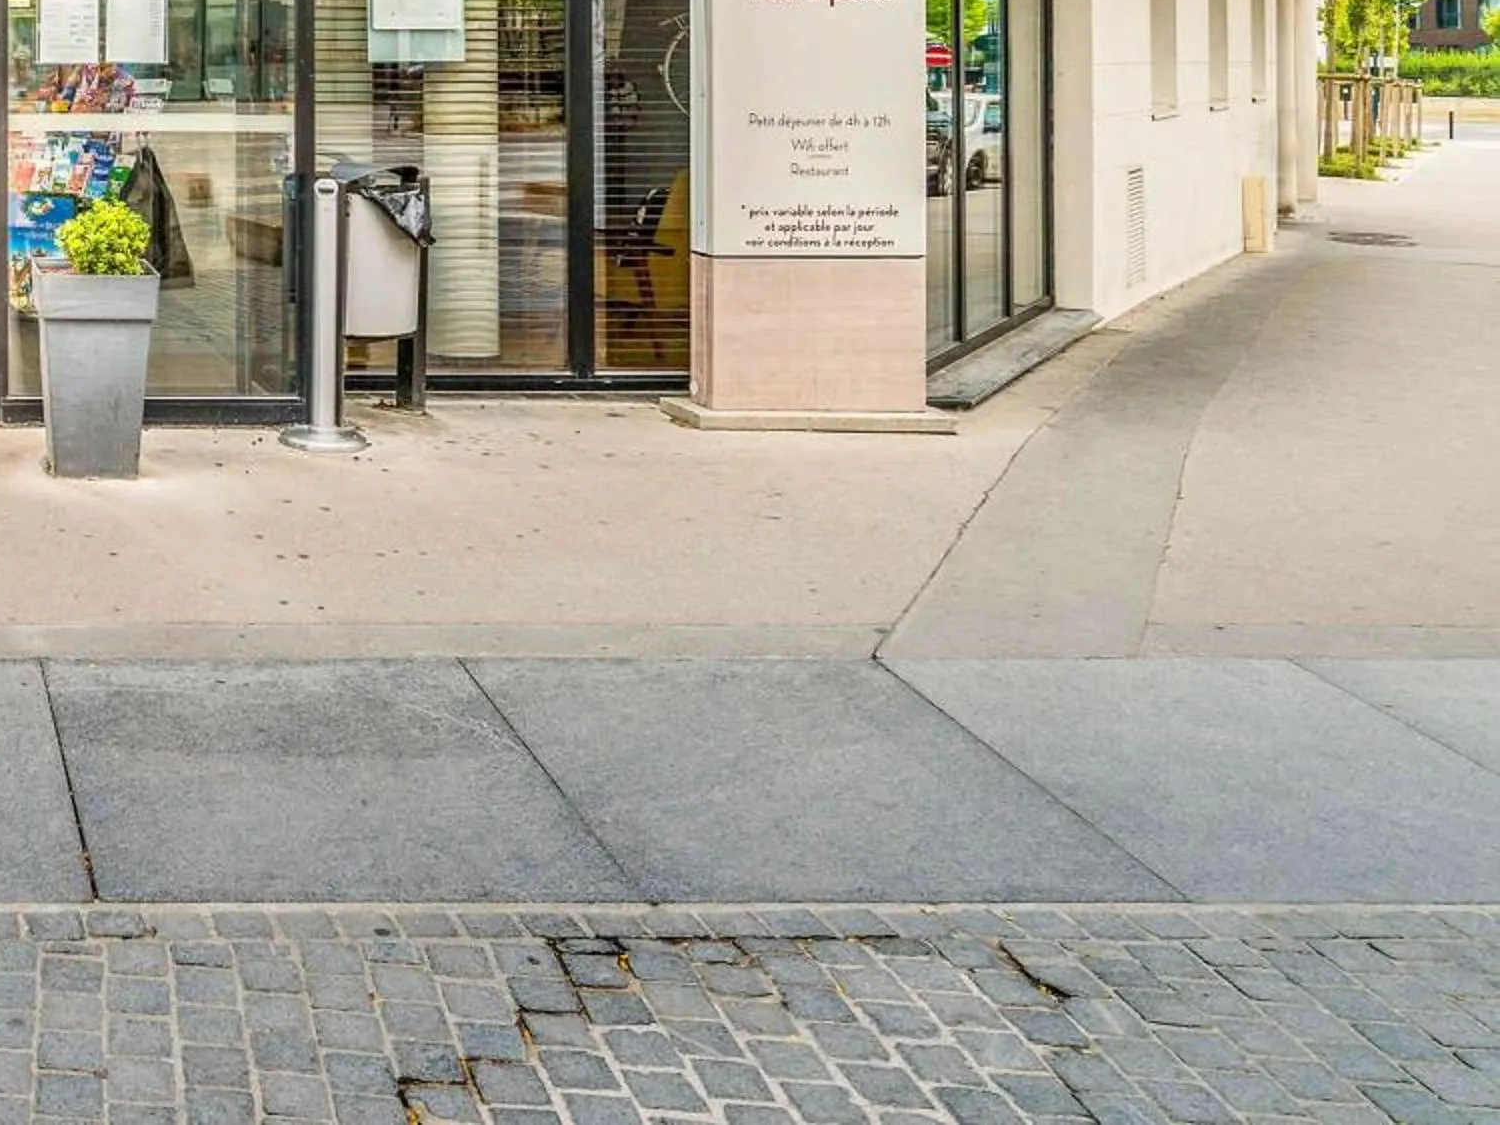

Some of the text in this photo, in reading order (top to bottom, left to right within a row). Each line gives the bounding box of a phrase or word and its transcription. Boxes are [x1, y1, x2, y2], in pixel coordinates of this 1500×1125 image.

[748, 112, 775, 126] Petit
[828, 113, 842, 126] de
[818, 137, 849, 152] offert
[789, 162, 850, 176] Restaurant
[749, 204, 899, 219] prix variable selon la période
[764, 220, 875, 235] et applicable par jour
[767, 236, 821, 248] conditions
[832, 235, 841, 247] la
[843, 236, 895, 250] réception
